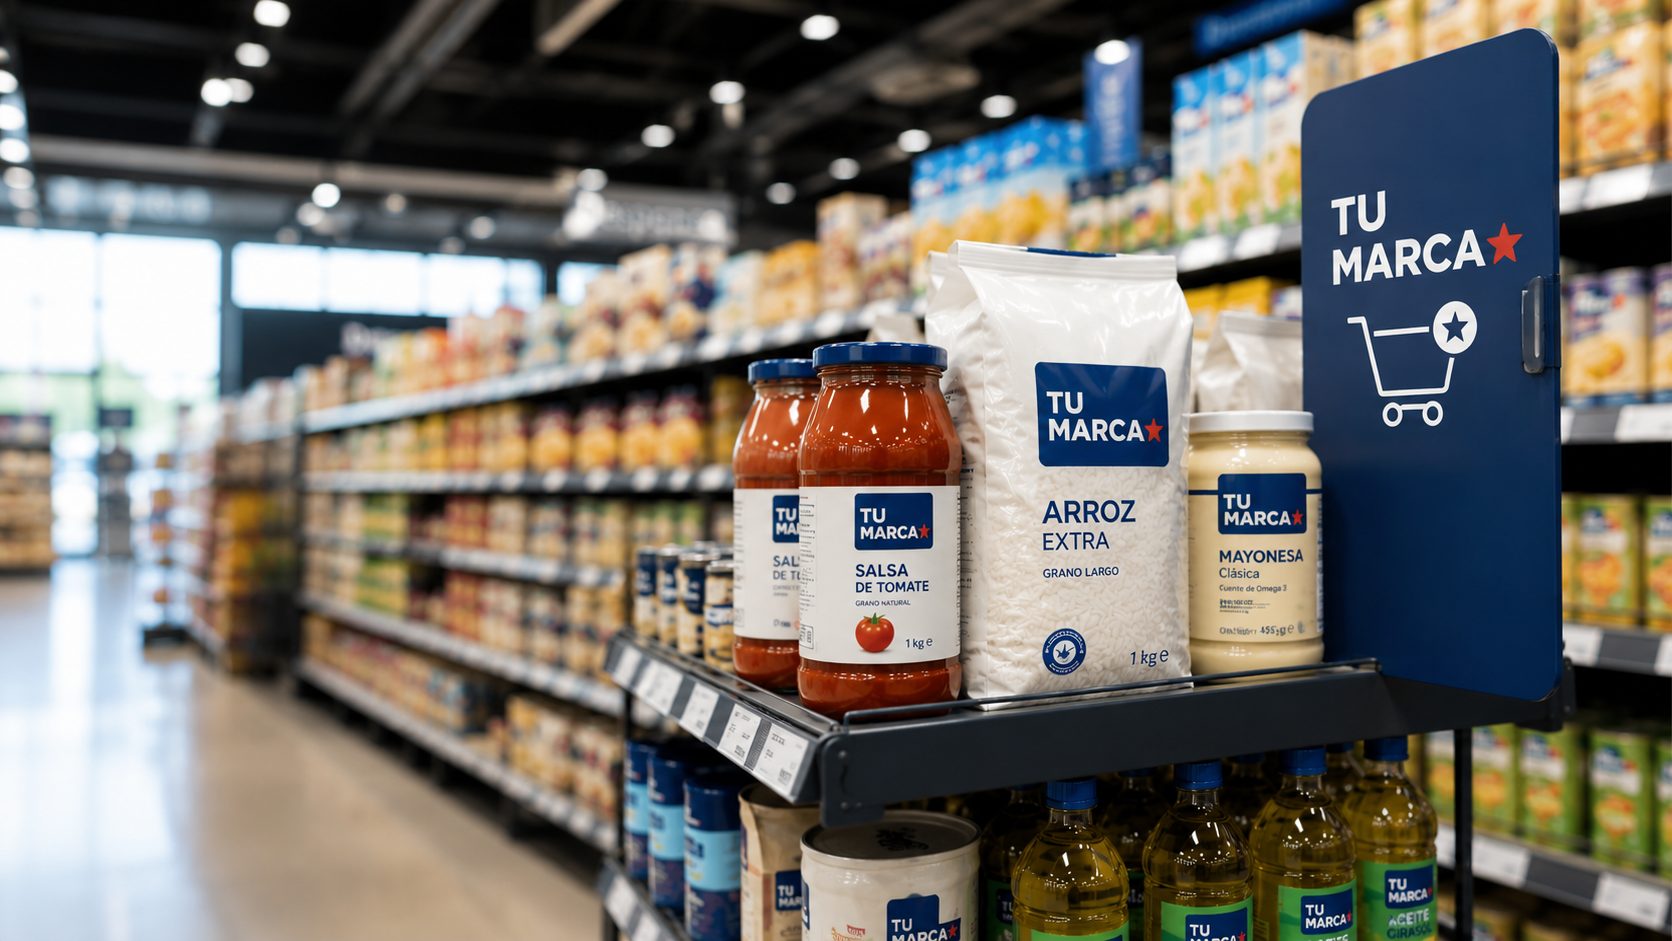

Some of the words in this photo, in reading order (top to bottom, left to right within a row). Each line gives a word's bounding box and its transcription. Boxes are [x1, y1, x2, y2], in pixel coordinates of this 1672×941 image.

[1331, 190, 1386, 236] TU
[1332, 229, 1487, 286] MARCA
[1046, 391, 1084, 415] TU
[1048, 418, 1146, 442] MARCA
[1223, 493, 1251, 510] TU
[775, 507, 797, 521] TU
[859, 507, 886, 524] TU
[1042, 499, 1137, 524] ARROZ
[1224, 510, 1292, 526] MARCA
[860, 525, 919, 540] MARCA
[1042, 531, 1110, 551] EXTRA
[1219, 549, 1304, 563] MAYONESA
[773, 570, 787, 581] DE
[855, 563, 909, 578] SALSA
[1042, 567, 1083, 579] GRANO
[1085, 566, 1120, 577] LARGO
[1219, 567, 1260, 579] Clásica
[855, 581, 873, 593] DE
[876, 580, 930, 593] TOMATE
[1246, 584, 1255, 593] de
[1256, 585, 1282, 594] Omega
[1282, 584, 1288, 592] 3
[881, 599, 911, 607] NATURAL
[905, 639, 911, 648] 1
[912, 638, 924, 650] kg
[1130, 651, 1136, 665] 1
[1140, 650, 1157, 668] kg
[777, 885, 794, 897] TU
[1388, 878, 1408, 891] TU
[1388, 888, 1428, 904] MARCA
[1305, 904, 1325, 916] TU
[1388, 908, 1430, 926] ACEITE
[891, 918, 913, 933] TU
[1305, 913, 1347, 930] MARCA
[1189, 924, 1211, 937] TU
